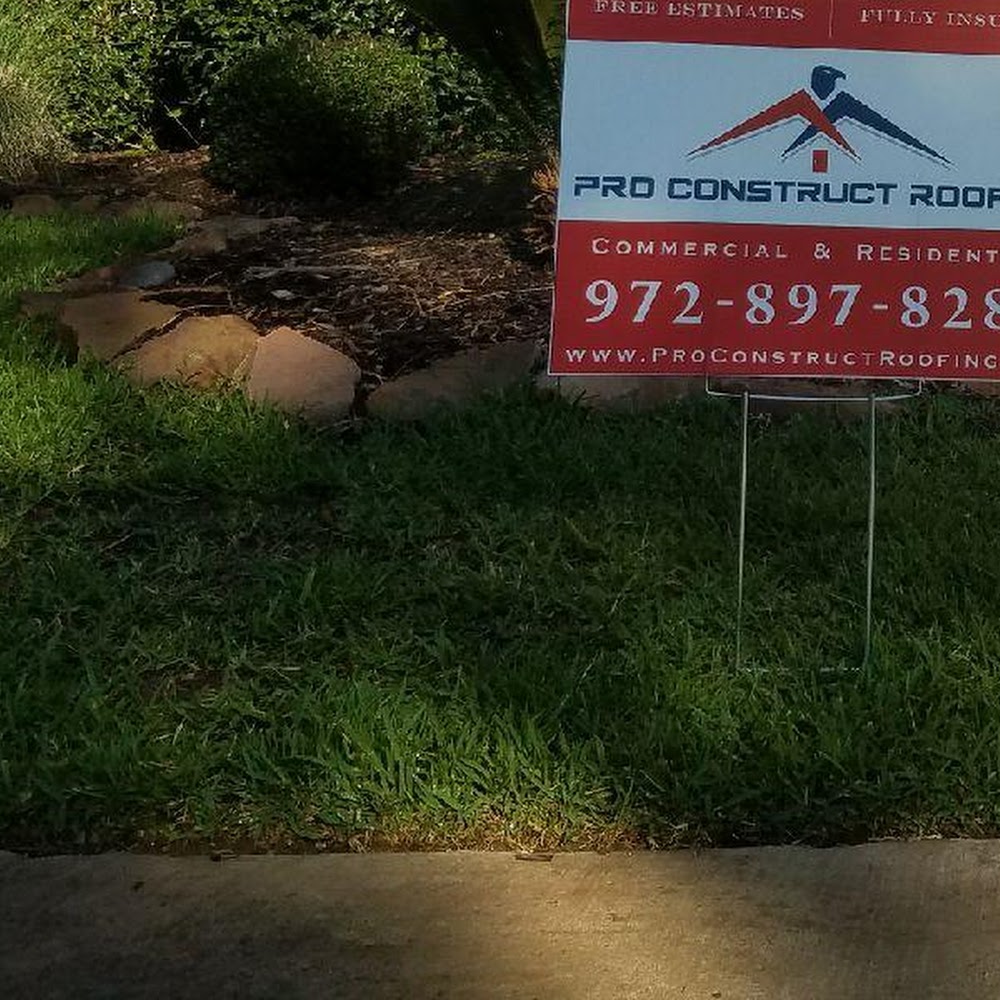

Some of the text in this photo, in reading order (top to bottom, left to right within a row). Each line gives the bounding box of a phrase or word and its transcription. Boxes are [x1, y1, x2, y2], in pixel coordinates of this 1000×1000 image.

[595, 0, 805, 20] FREE ESTIMATES
[860, 9, 937, 24] FULLY
[574, 176, 656, 199] PRO
[668, 178, 898, 205] CONSTRUCT
[592, 238, 788, 259] COMMERCIAL
[814, 243, 831, 260] &
